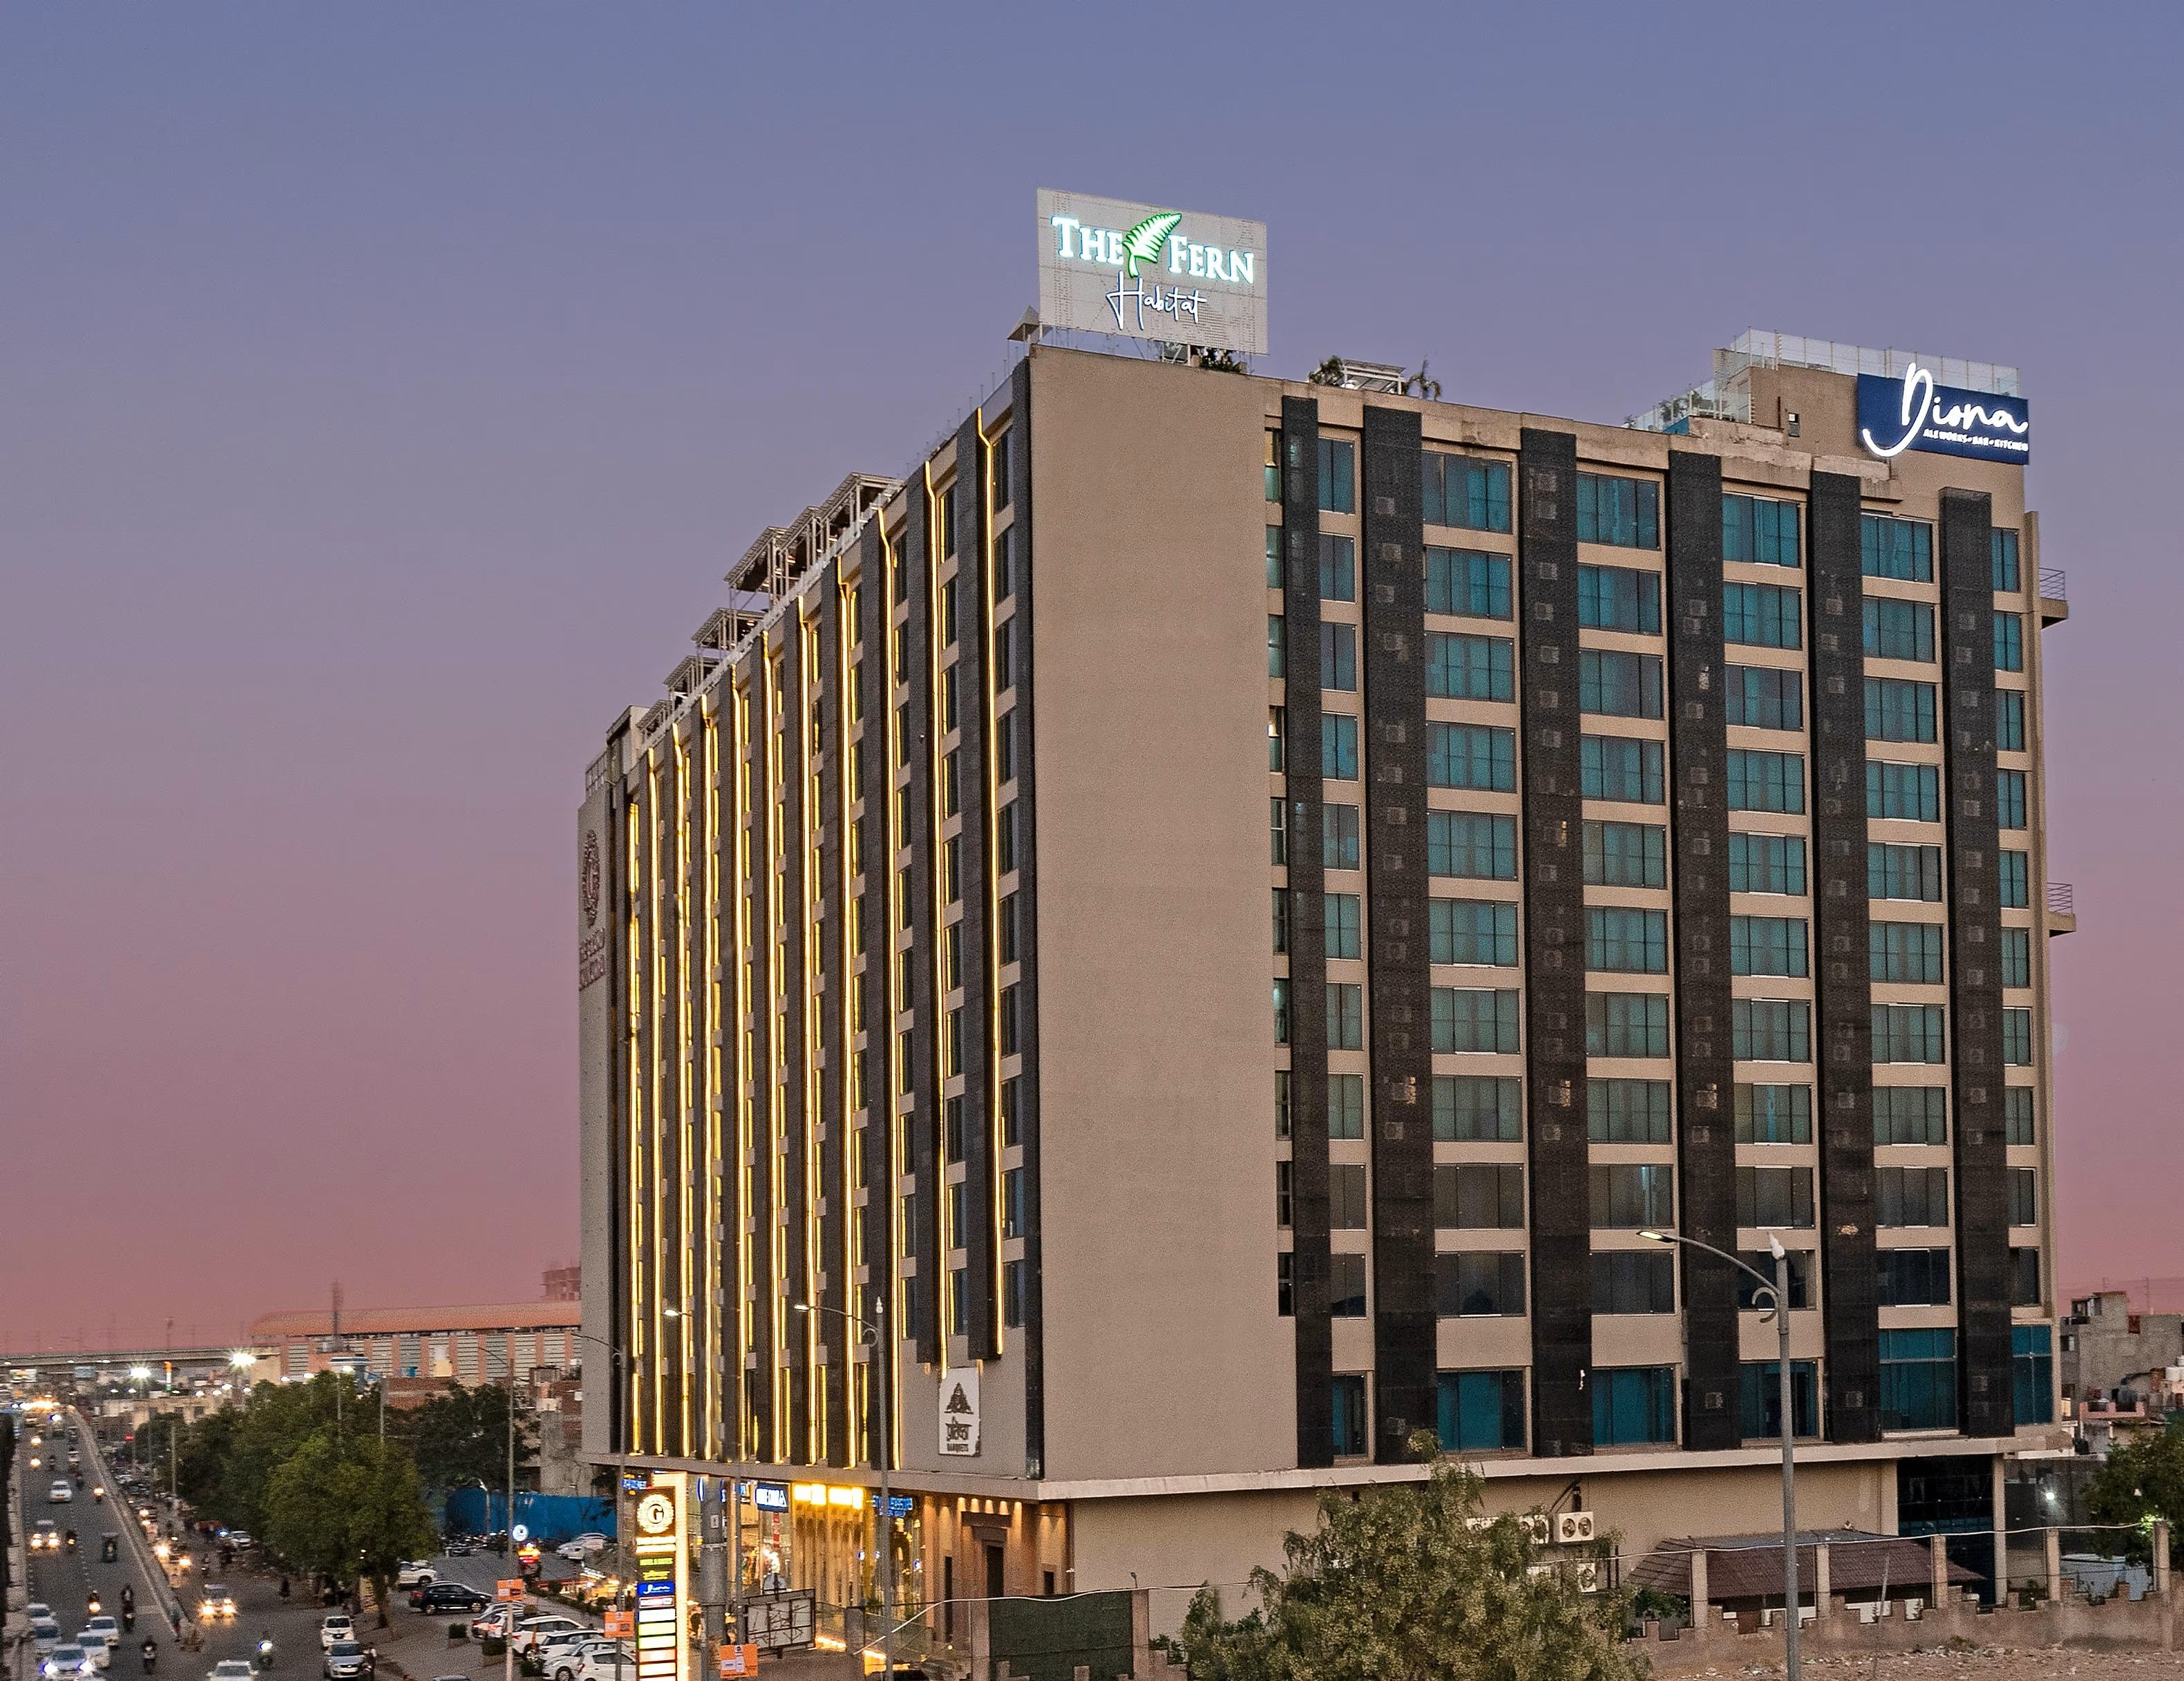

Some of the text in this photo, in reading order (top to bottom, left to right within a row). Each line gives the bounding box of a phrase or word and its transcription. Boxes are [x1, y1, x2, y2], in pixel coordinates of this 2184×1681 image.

[1050, 215, 1255, 285] THE FERN
[1106, 271, 1208, 330] Habitat
